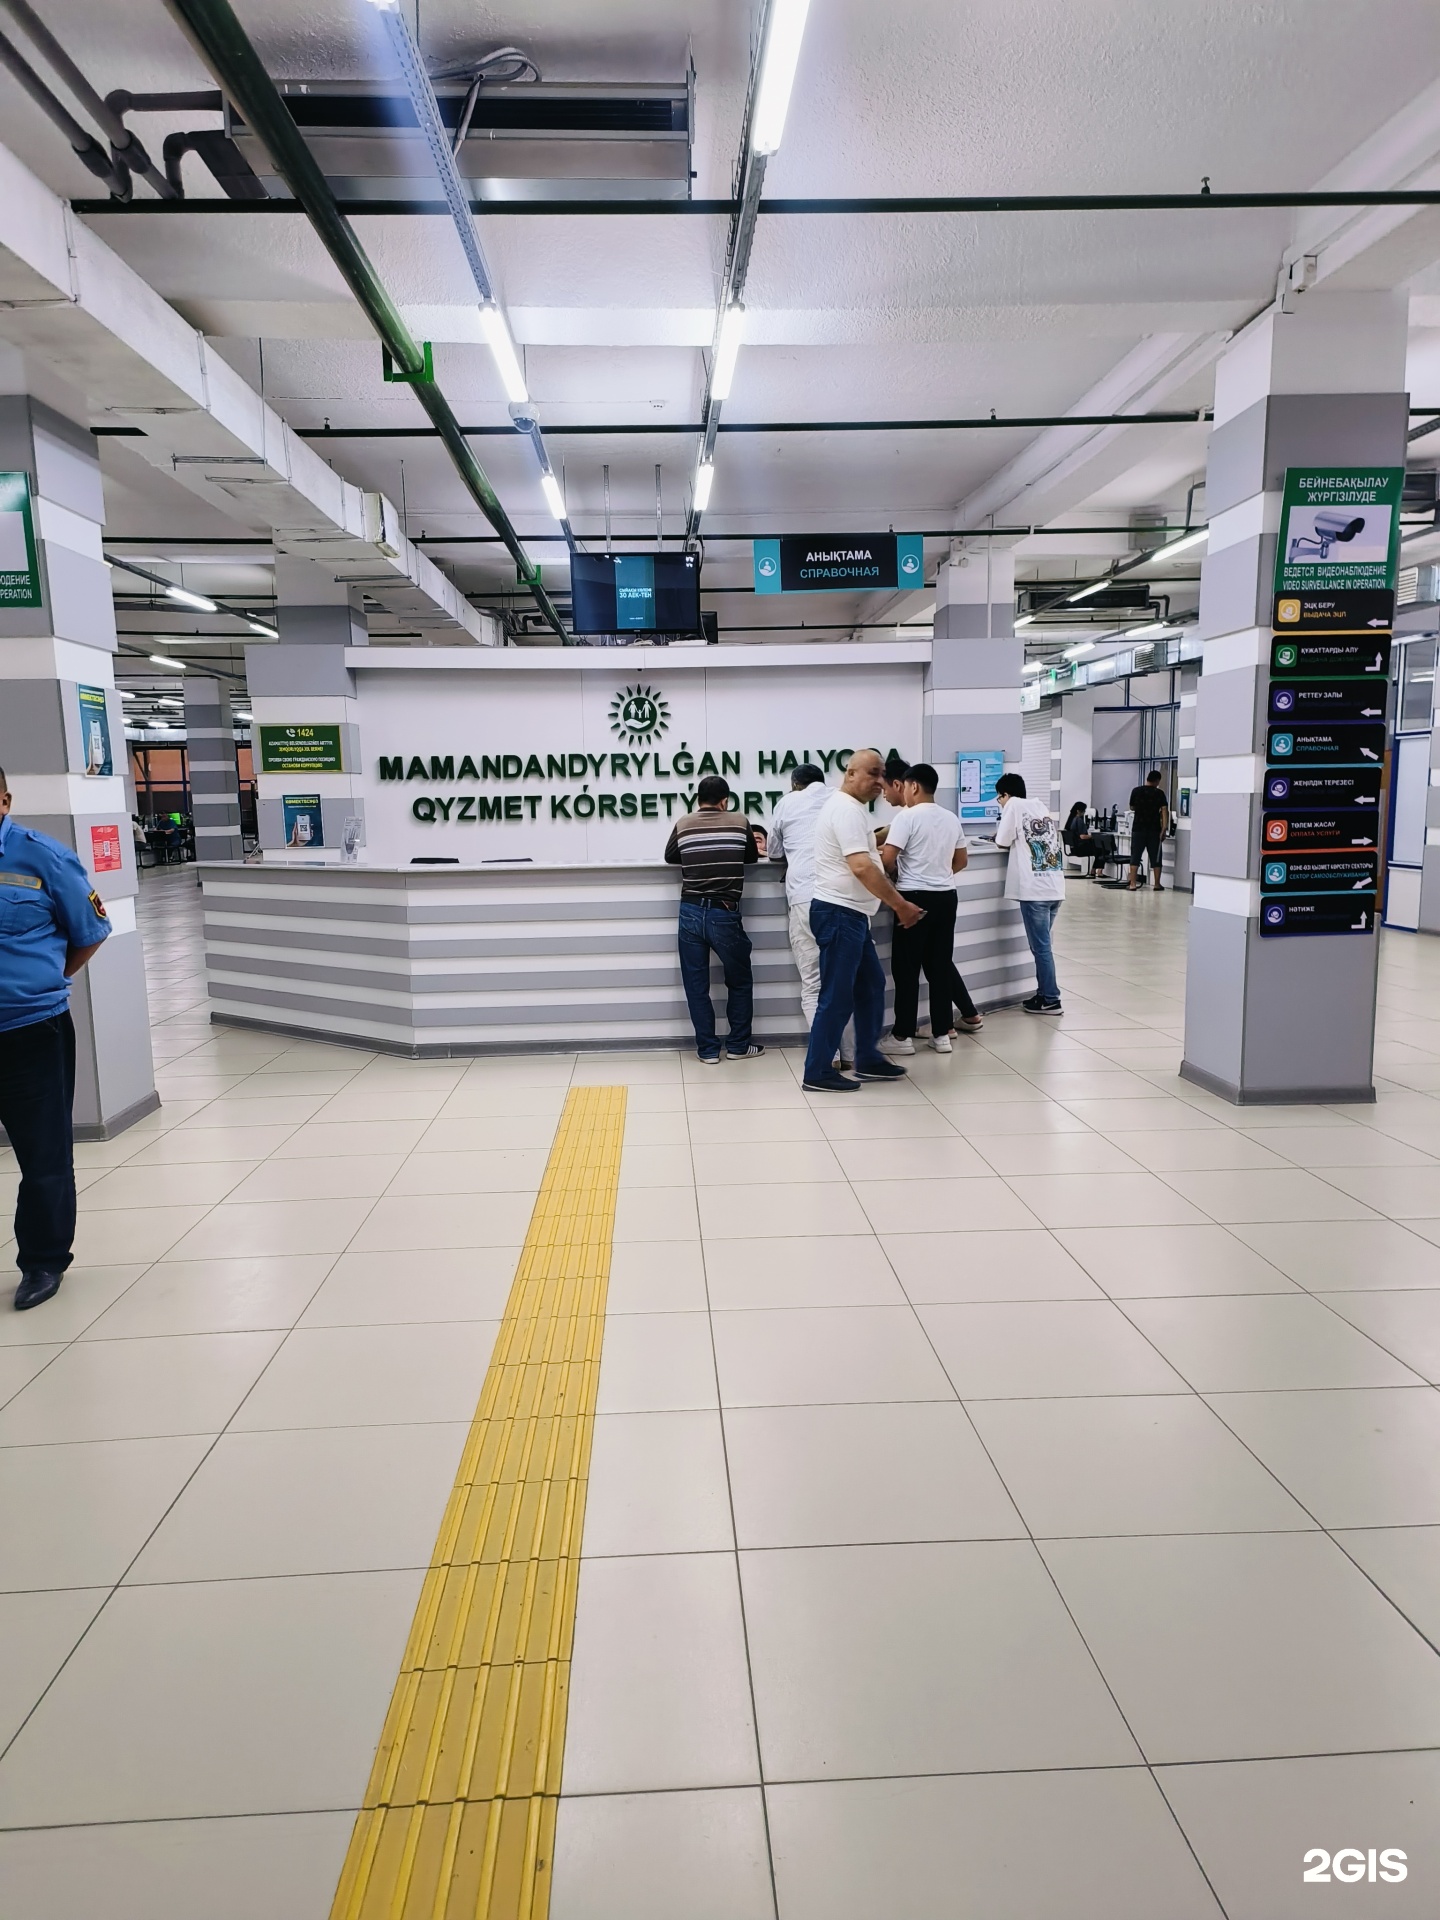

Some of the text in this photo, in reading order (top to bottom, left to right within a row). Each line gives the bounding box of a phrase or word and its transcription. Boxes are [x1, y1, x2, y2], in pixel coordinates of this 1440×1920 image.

[1299, 476, 1389, 489] БЕЙНЕБАҚЫЛАУ
[1308, 492, 1376, 503] ЖҮРГІЗІЛУДЕ
[806, 550, 872, 562] АНЫҚТАМА
[800, 566, 879, 578] СПРАВОЧНАЯ
[1284, 566, 1386, 578] ВЕДЕТСЯ ВИДЕОНАБЛЮДЕНИЕ
[1283, 579, 1386, 590] VIDEO SURVEILLANCE IN OPERATION
[297, 728, 314, 737] 1424
[379, 742, 740, 780] MAMANDANDYRYLǴAN
[412, 796, 542, 822] QYZMET
